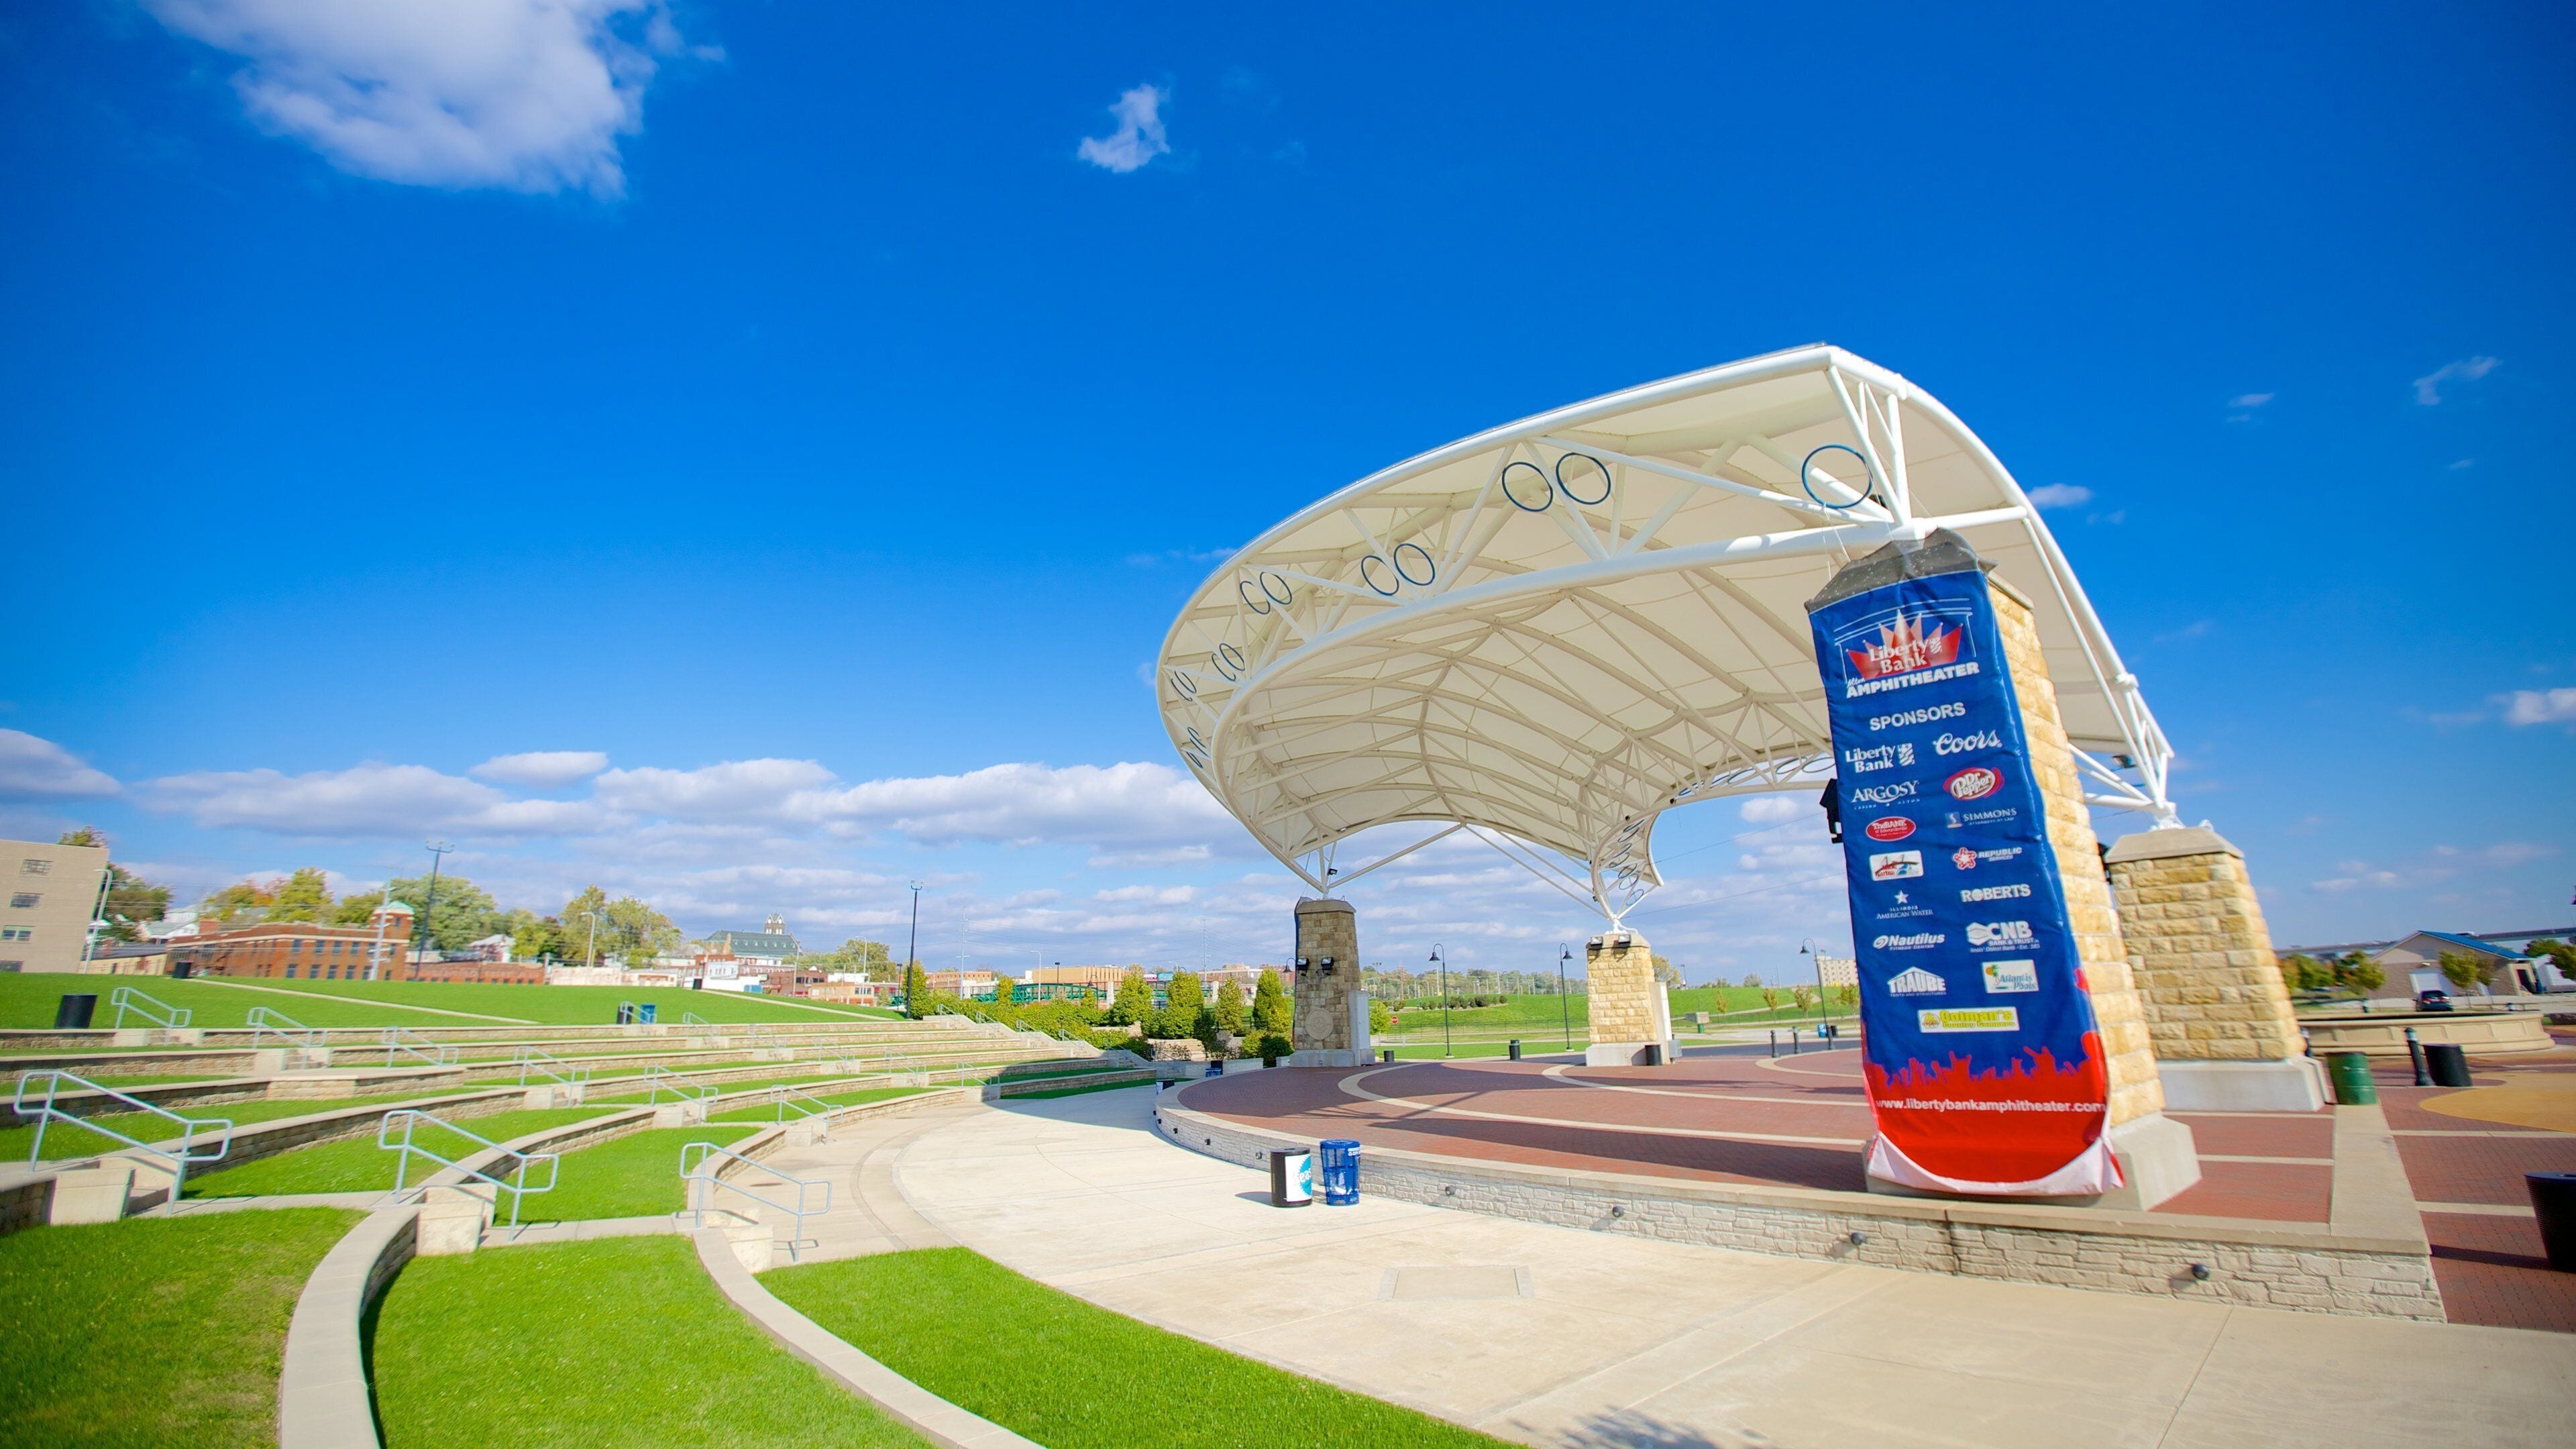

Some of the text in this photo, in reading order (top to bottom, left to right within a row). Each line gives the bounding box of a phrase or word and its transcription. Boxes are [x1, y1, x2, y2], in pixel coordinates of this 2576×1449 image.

[1868, 638, 1929, 661] Liberty
[1880, 653, 1927, 674] Bank
[1847, 662, 1980, 698] AMPHITHEATER
[1870, 702, 1966, 731] SPONSORS
[1934, 730, 2000, 755] Coors
[1845, 745, 1895, 763] Liberty
[1854, 755, 1894, 773] Bank
[1953, 774, 1992, 798] Pepper
[1964, 773, 1980, 784] Dr
[1851, 780, 1919, 803] ARGOSY
[1964, 807, 2017, 822] SIMMONS
[1978, 847, 2023, 858] REPUBLIC
[1960, 883, 2031, 902] ROBERTS
[1877, 912, 1910, 920] AMERICAN
[1987, 920, 2033, 940] CNB
[1888, 932, 1945, 947] Nautilus
[1888, 972, 1946, 993] TRAUBE
[2000, 973, 2033, 982] Atlantis
[2013, 981, 2035, 989] Pools
[1939, 1010, 2012, 1022] Colman's
[1876, 1098, 2106, 1113] www.libertybankamphitheater.com
